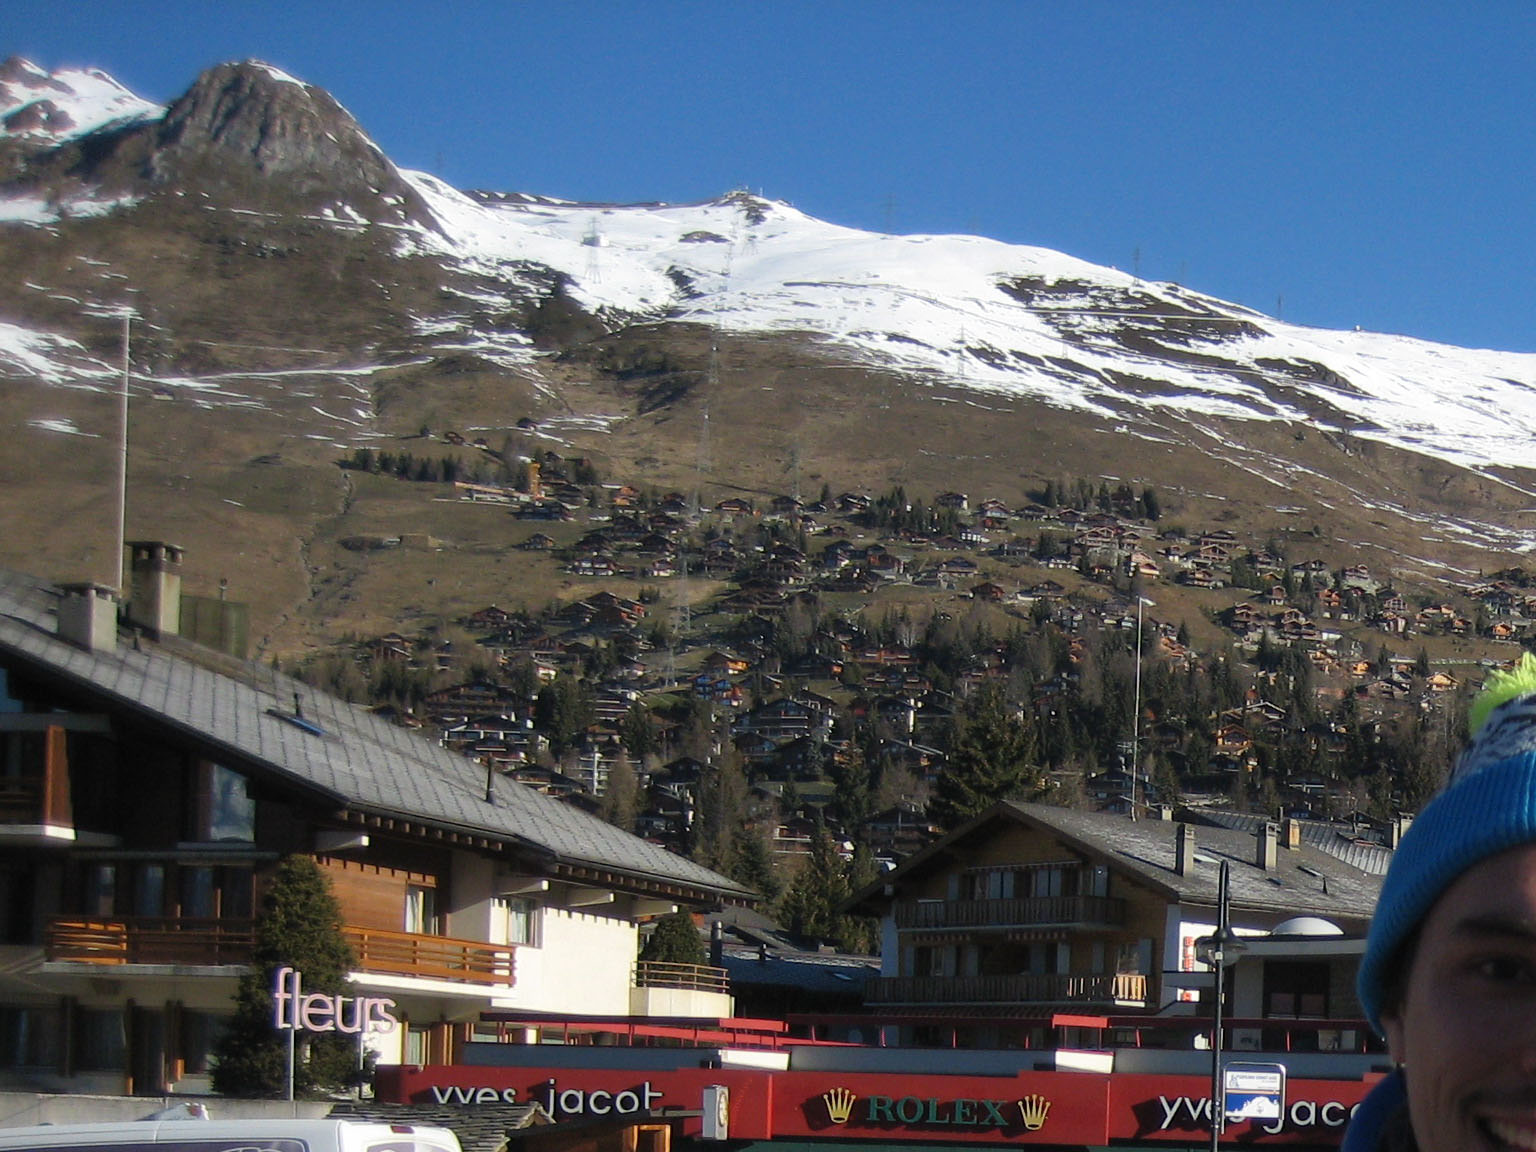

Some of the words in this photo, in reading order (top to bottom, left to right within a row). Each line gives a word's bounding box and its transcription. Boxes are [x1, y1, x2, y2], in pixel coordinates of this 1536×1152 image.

[274, 966, 397, 1034] fleurs
[549, 1078, 663, 1118] jacot
[866, 1095, 1009, 1126] ROLEX
